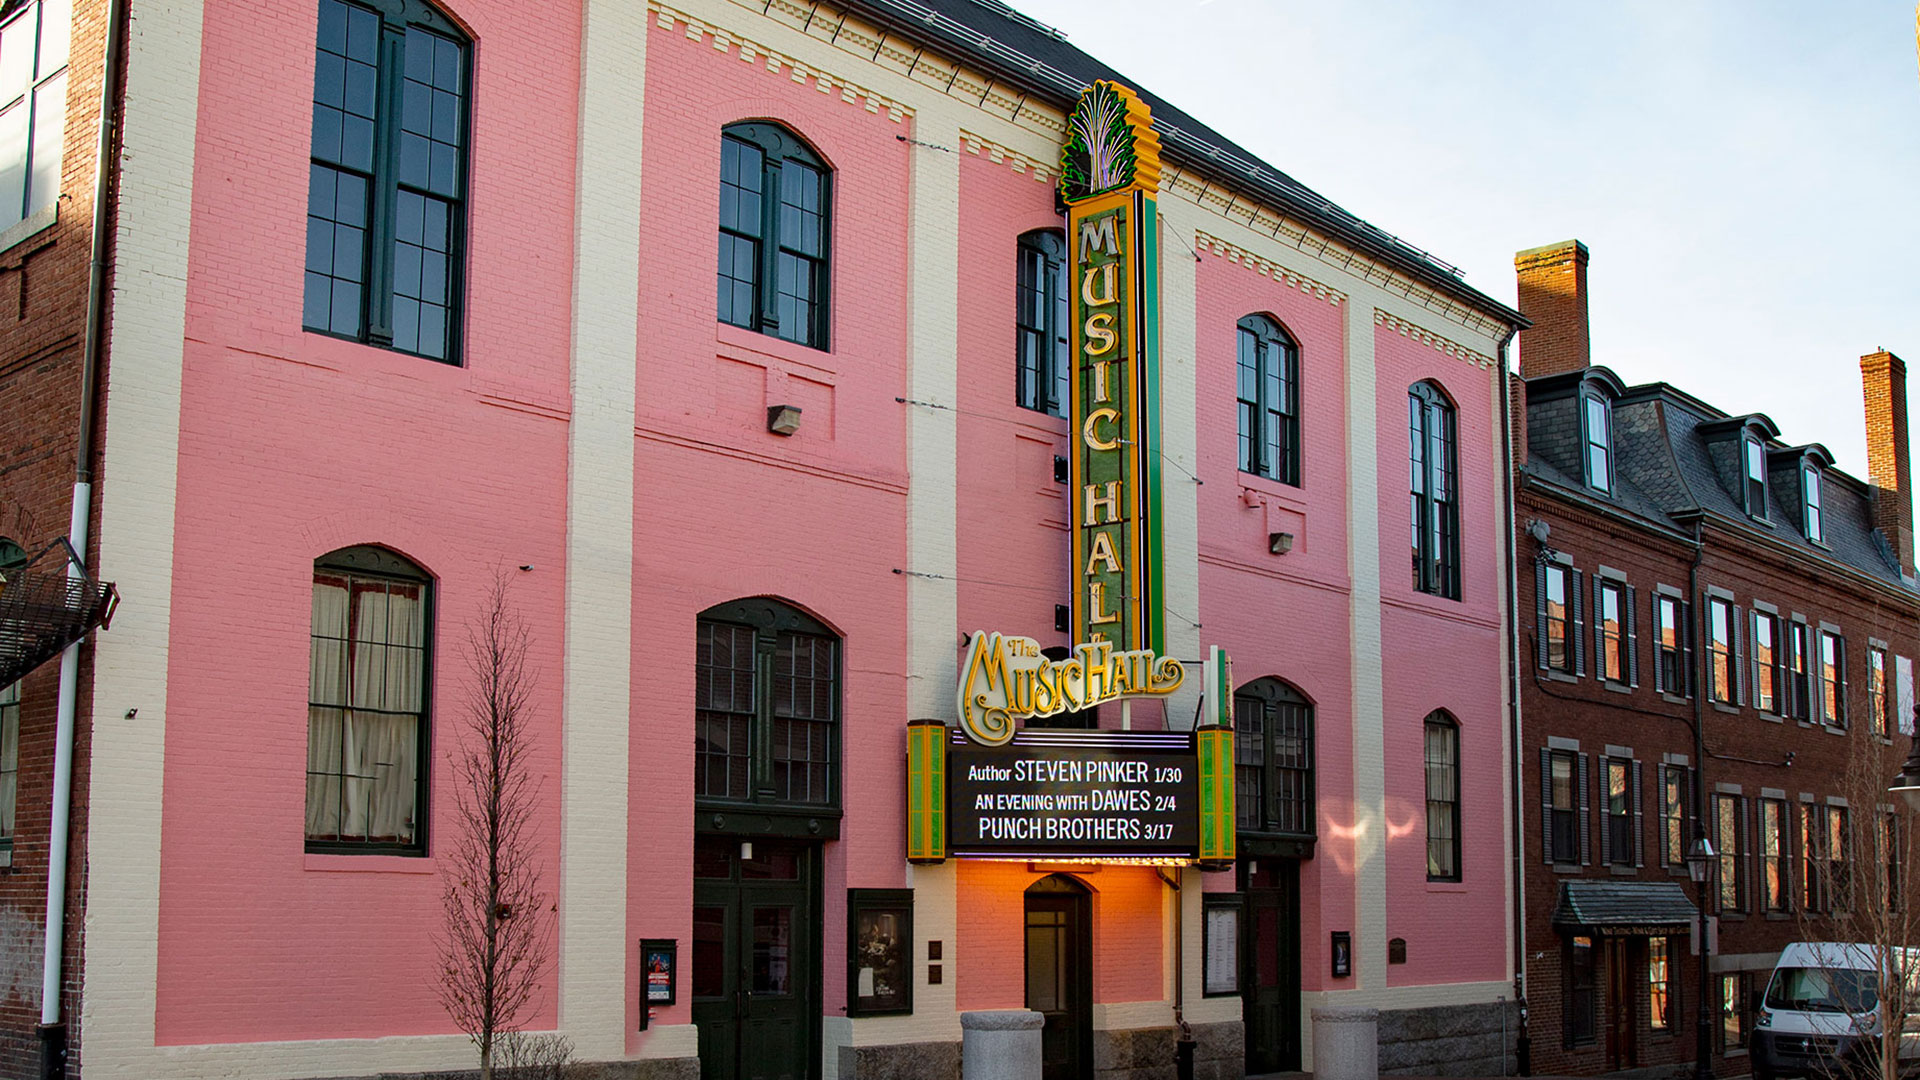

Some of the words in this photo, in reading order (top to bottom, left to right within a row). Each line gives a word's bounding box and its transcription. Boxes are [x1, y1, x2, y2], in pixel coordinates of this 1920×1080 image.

[1078, 215, 1121, 450] MUSIC
[1083, 480, 1123, 643] HAL
[1007, 639, 1039, 658] The
[968, 765, 1012, 781] Author
[1014, 760, 1082, 782] STEVEN
[1086, 761, 1149, 783] PINKER
[1154, 767, 1183, 783] 1/30
[975, 794, 994, 810] AN
[997, 794, 1053, 810] EVENING
[1055, 795, 1088, 811] WITH
[1092, 790, 1151, 811] DAWES
[1155, 796, 1177, 812] 2/4
[979, 817, 1041, 839] PUNCH
[1046, 818, 1140, 840] BROTHERS
[1144, 824, 1173, 840] 3/17
